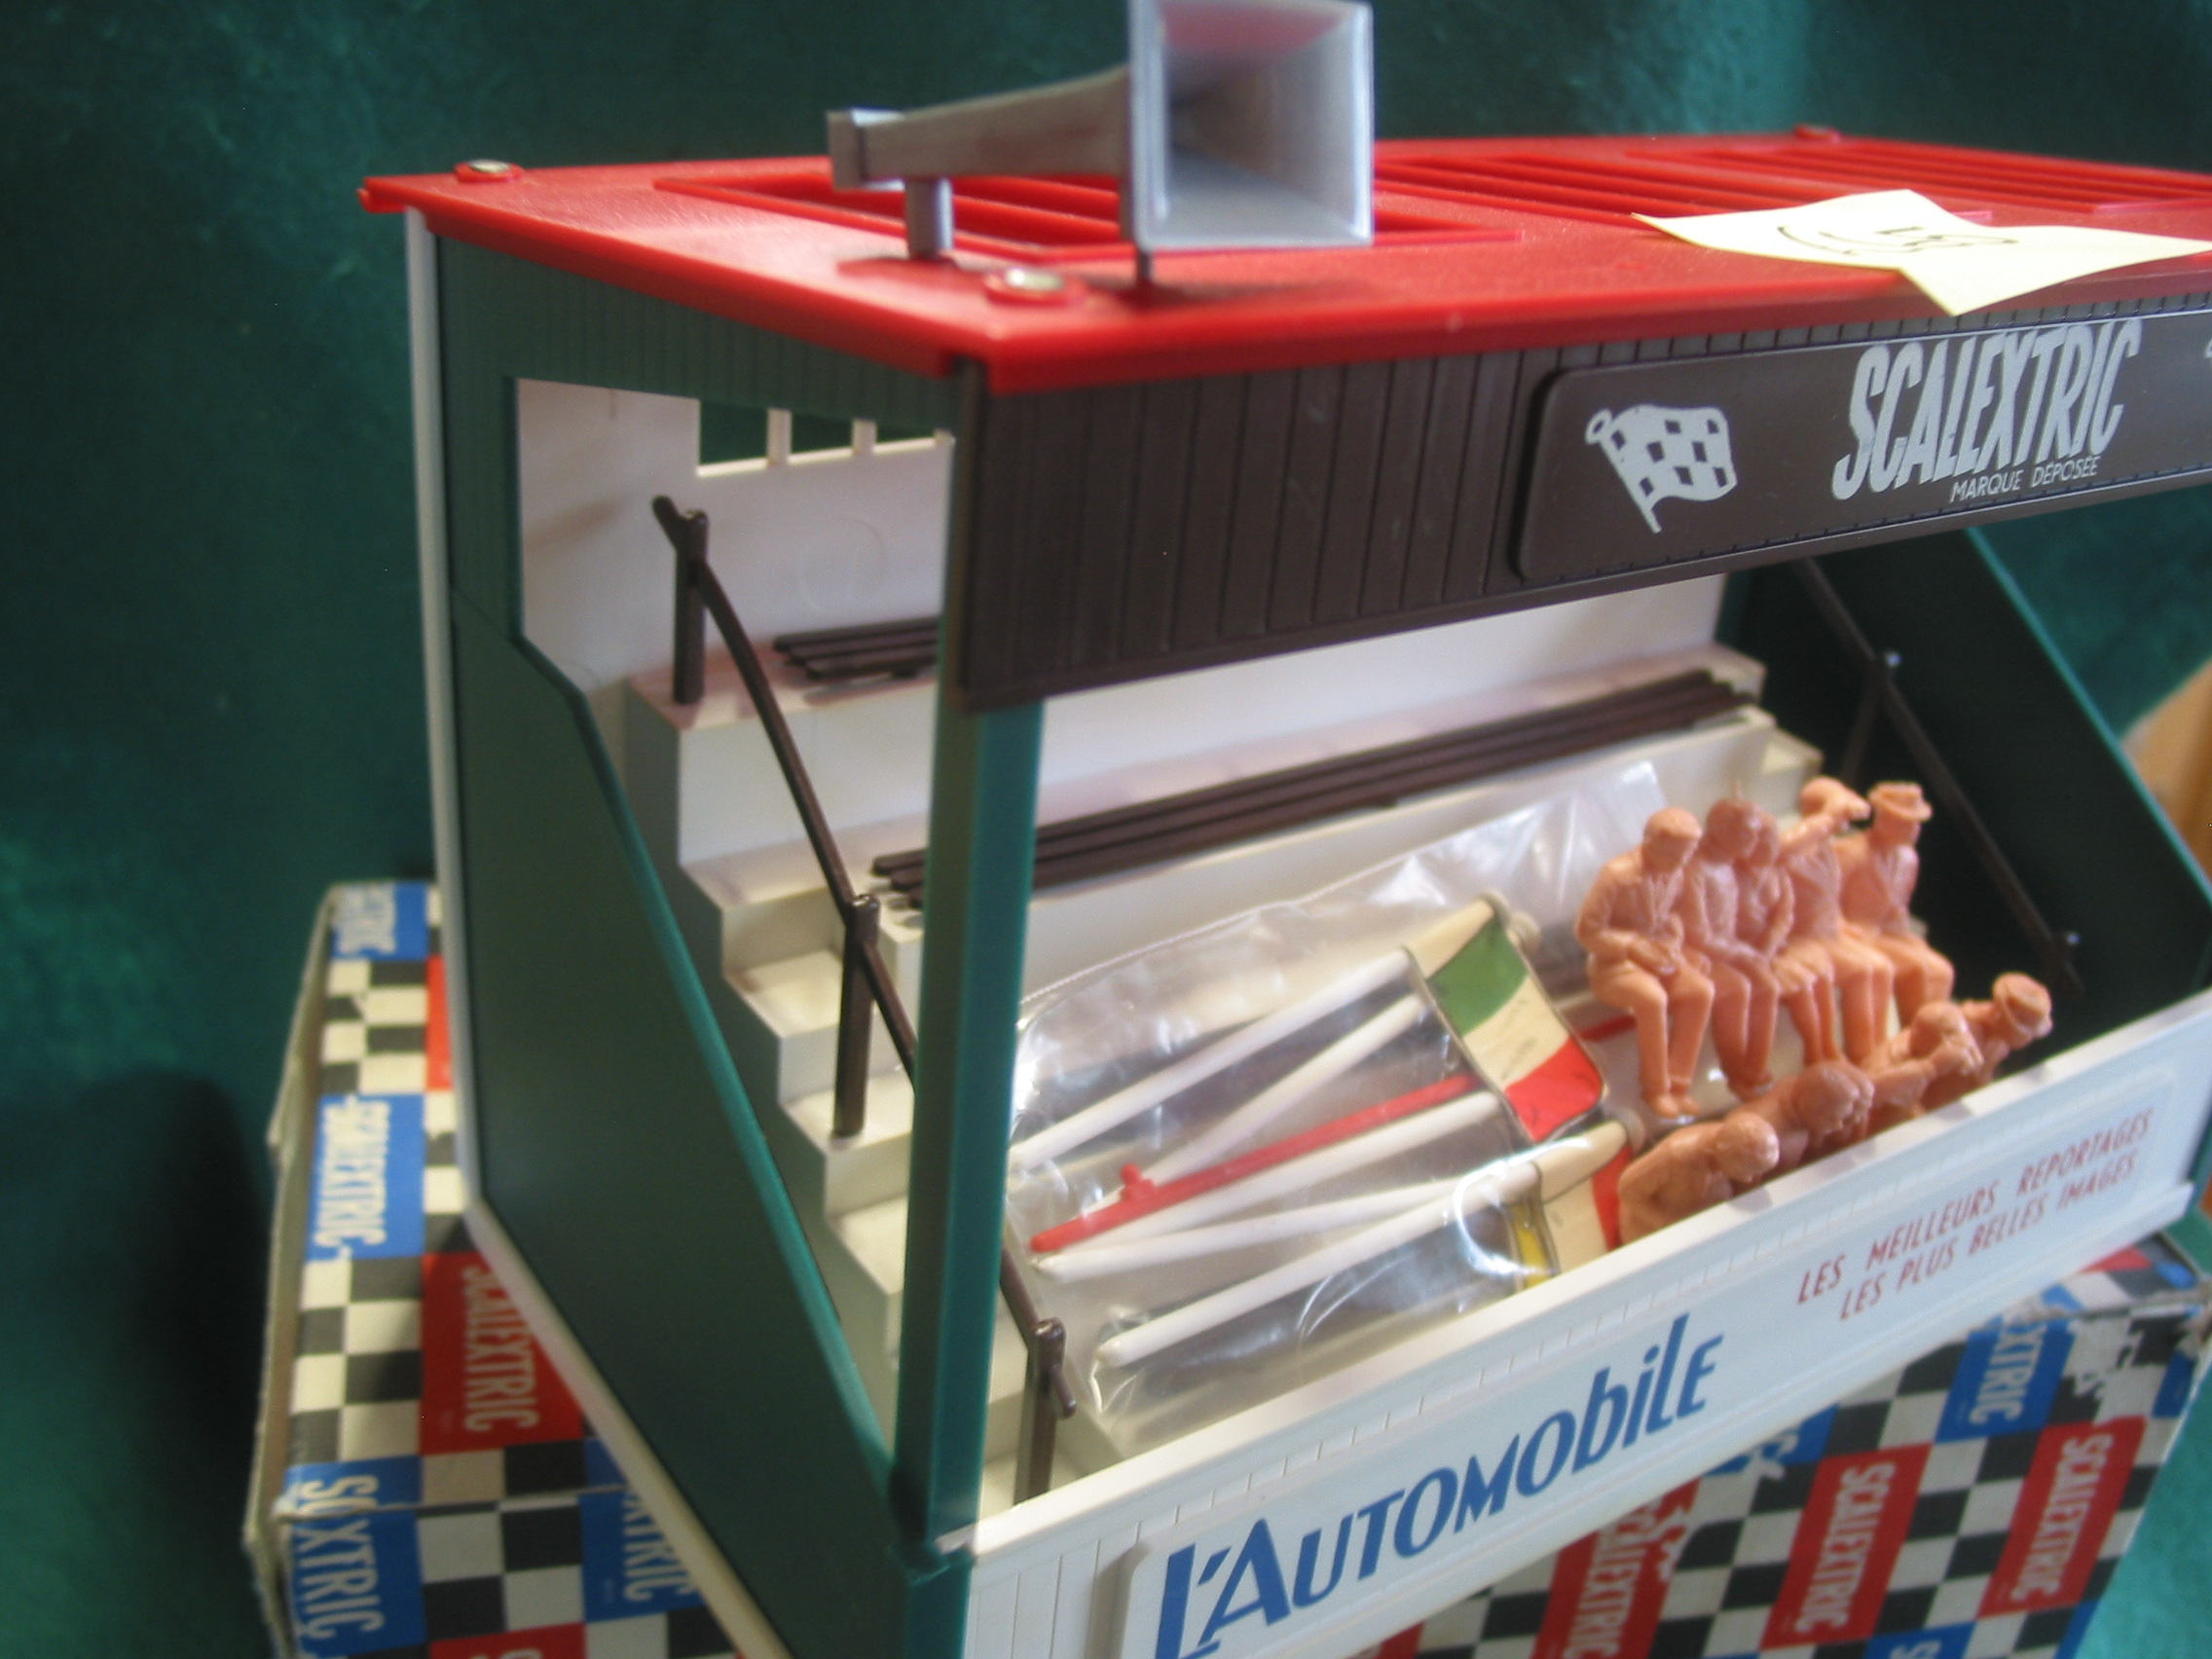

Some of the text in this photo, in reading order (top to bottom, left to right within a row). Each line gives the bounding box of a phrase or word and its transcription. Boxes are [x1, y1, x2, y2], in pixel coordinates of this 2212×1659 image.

[1831, 317, 2142, 500] SCALEXTRIC
[1949, 469, 2024, 503] MARQUE
[1798, 1106, 2155, 1305] LES MEILLEURS REPORTAGES
[1840, 1149, 2139, 1320] LES PLUS BELLES IMAGES
[1794, 1460, 1897, 1633] SCALEXTRIC
[2010, 1433, 2115, 1602] SCALEXTRIC
